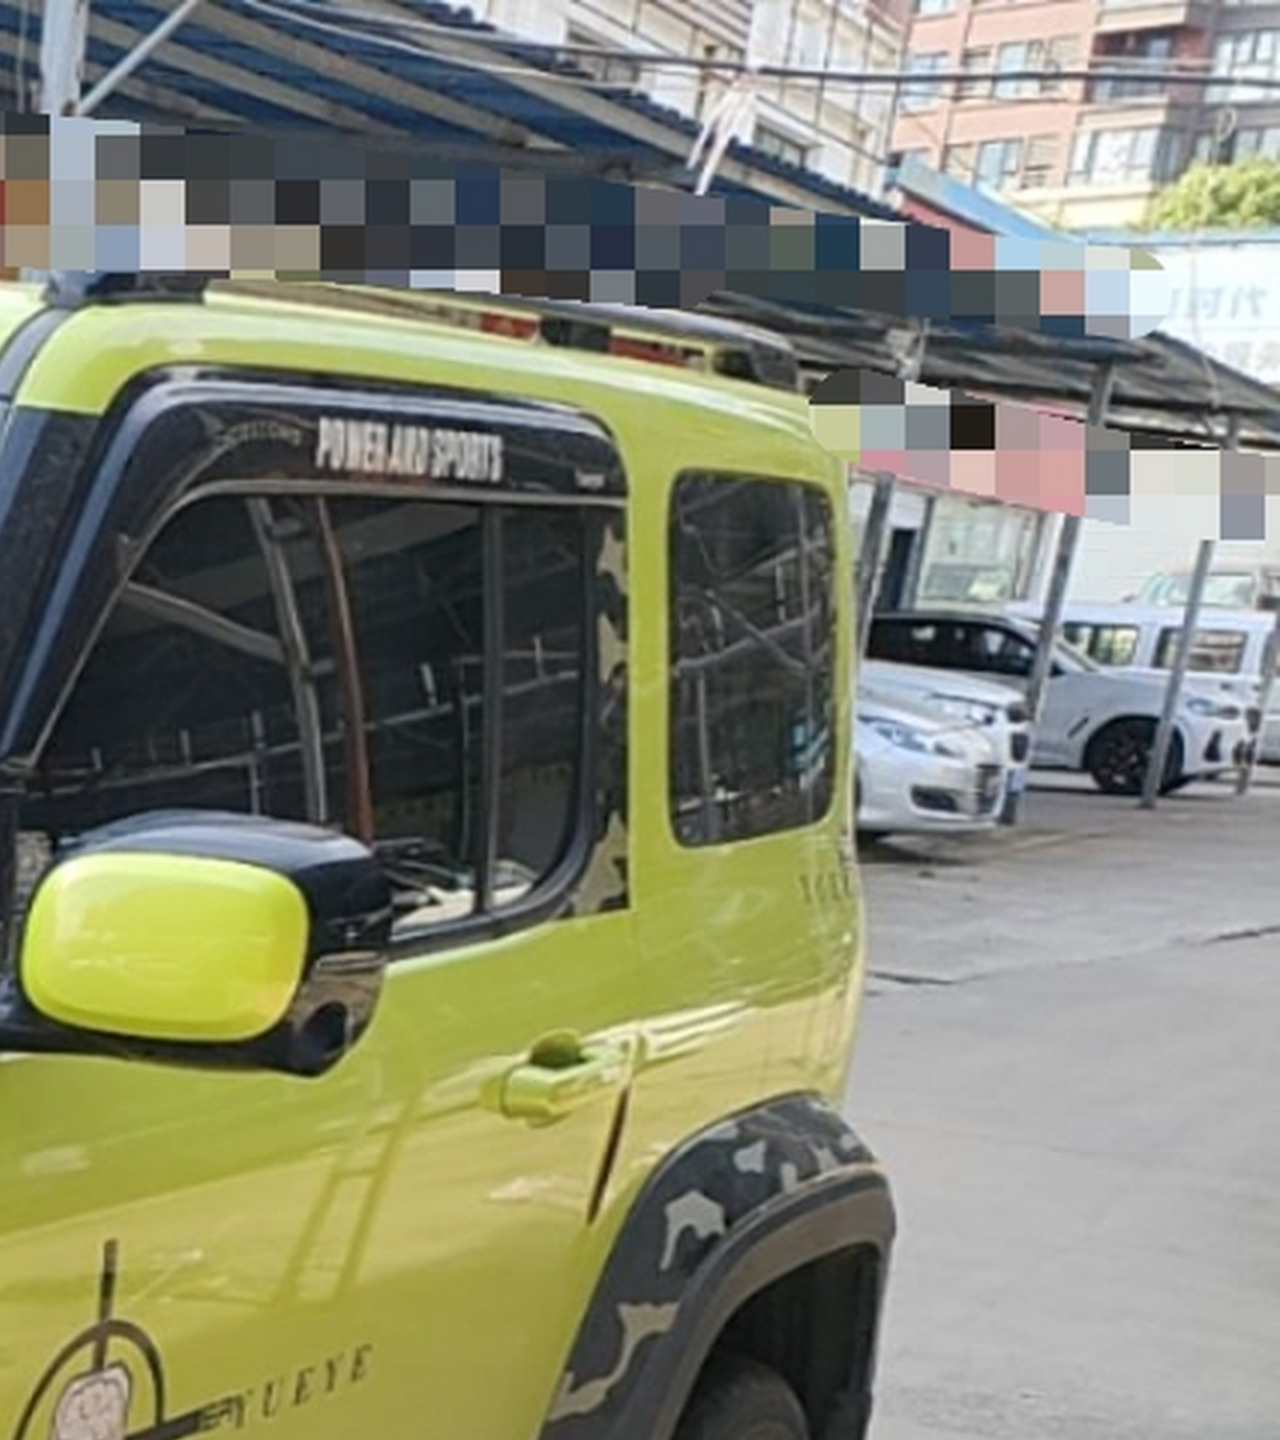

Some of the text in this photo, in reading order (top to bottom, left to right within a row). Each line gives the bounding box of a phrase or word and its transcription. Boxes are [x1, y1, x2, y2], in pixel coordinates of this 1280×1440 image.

[316, 416, 503, 483] POWER AND SPORTS
